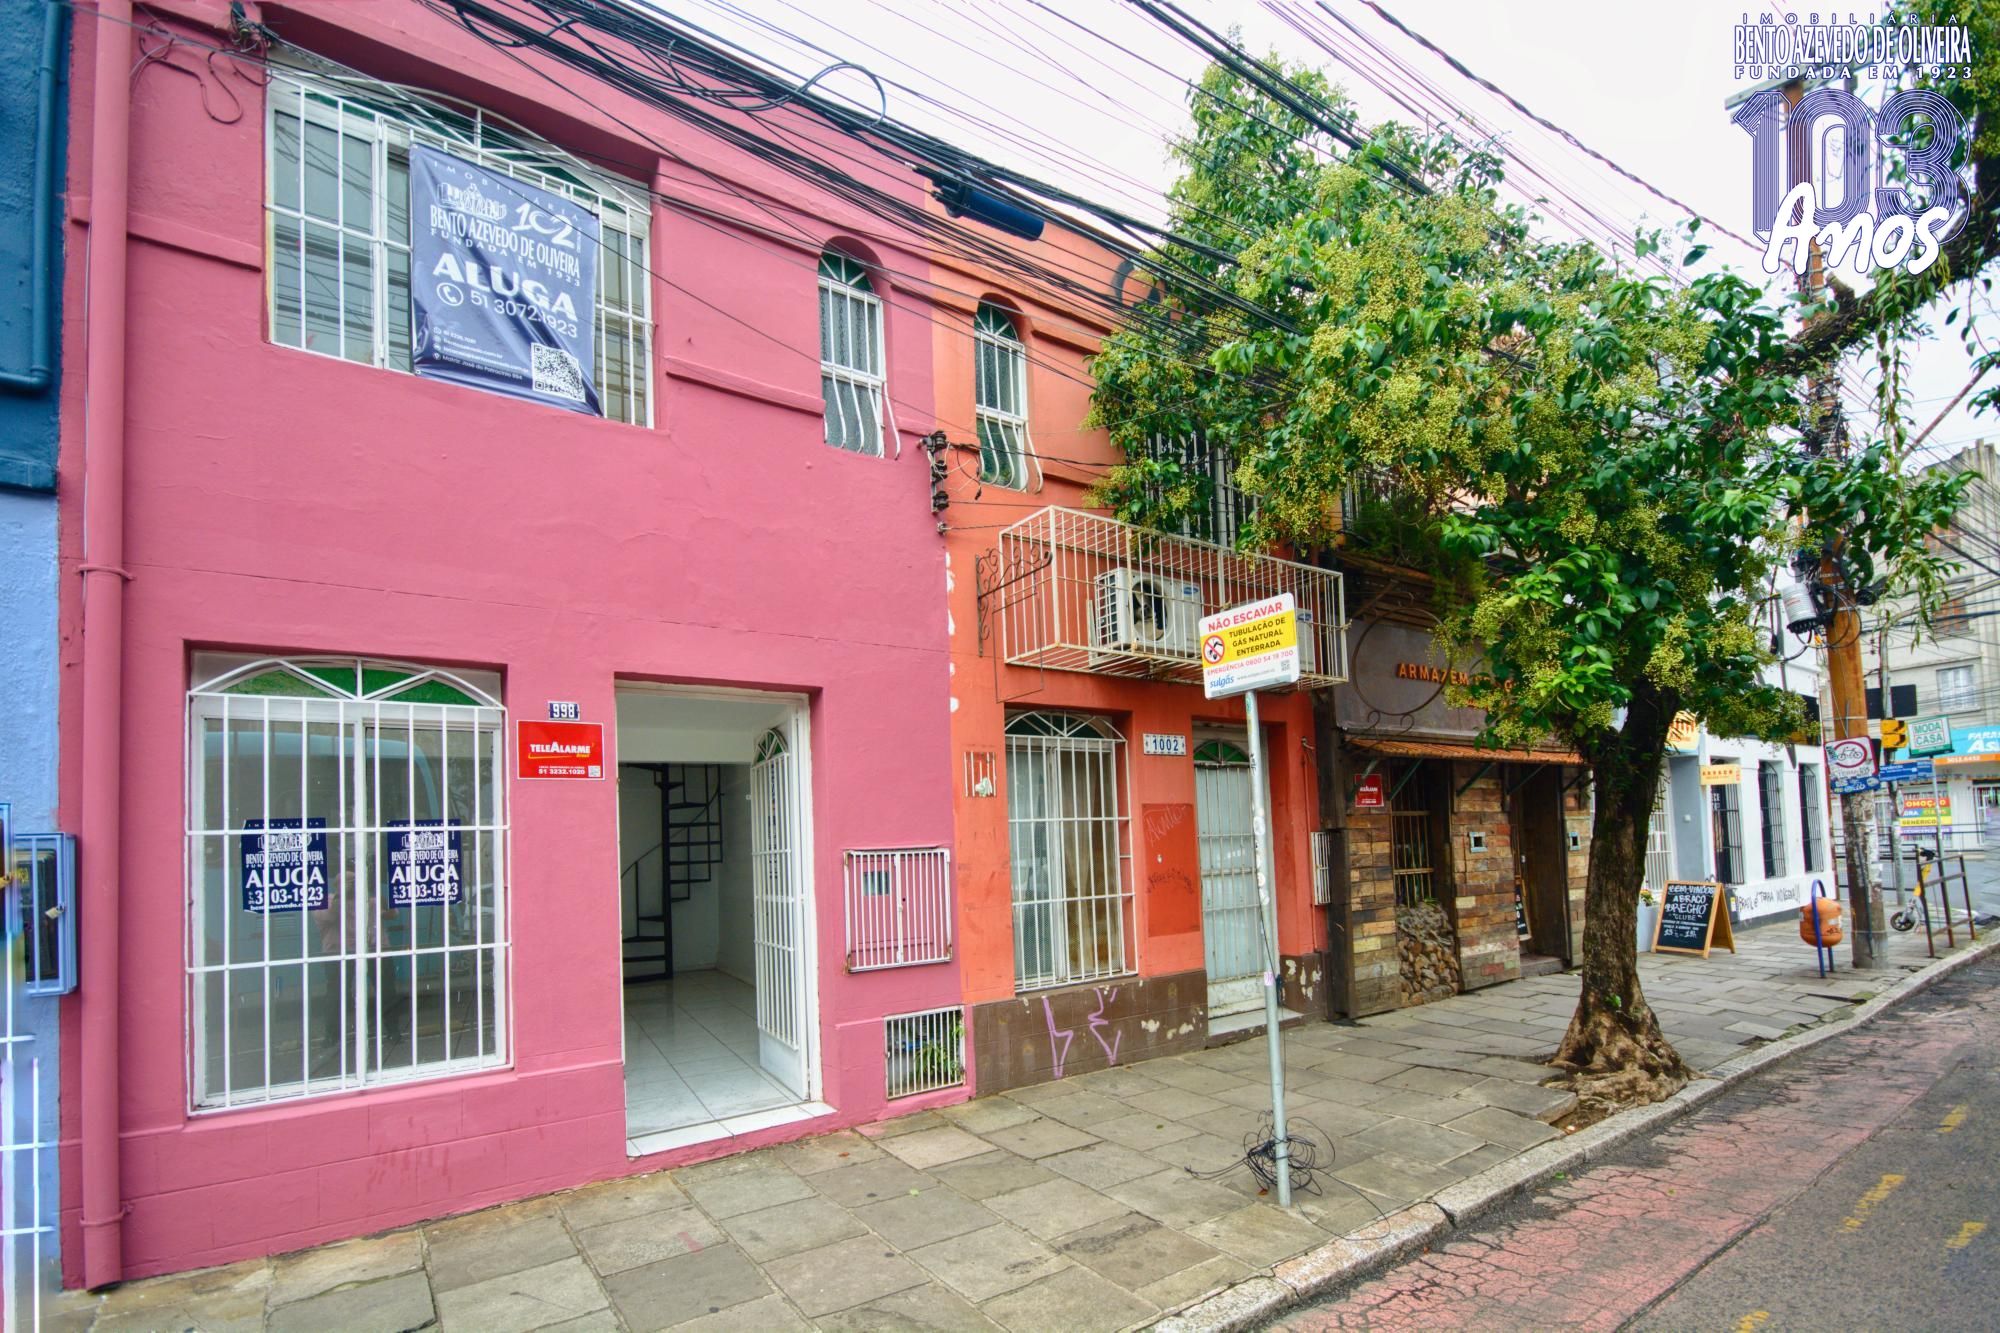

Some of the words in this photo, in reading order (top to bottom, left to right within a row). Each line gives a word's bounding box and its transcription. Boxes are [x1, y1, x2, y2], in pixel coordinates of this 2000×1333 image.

[430, 204, 467, 237] BENTO
[468, 217, 519, 253] AZEVEDO
[520, 235, 535, 261] DE
[536, 242, 581, 279] OLIVEIRA
[431, 227, 508, 257] FUNDADA
[518, 255, 537, 269] EM
[548, 267, 580, 287] 1923
[432, 252, 578, 322] ALUGA
[470, 290, 489, 308] 51
[1208, 616, 1231, 633] NÃO
[1233, 601, 1283, 625] ESCAVAR
[1229, 620, 1274, 638] TUBULAÇÃO
[1275, 616, 1286, 627] DE
[1248, 630, 1284, 645] NATURAL
[1236, 639, 1281, 657] ENTERRADA
[1207, 660, 1244, 676] EMERGÊNCIA
[1210, 674, 1235, 689] sulgás
[553, 703, 575, 718] 998
[1913, 722, 1941, 734] MODA
[1152, 738, 1179, 752] 1002
[1916, 733, 1943, 746] CASA
[246, 853, 265, 865] BENTO
[265, 851, 291, 863] ZEVEDO
[291, 851, 300, 863] DE
[430, 850, 437, 861] DE
[391, 864, 459, 884] ALUGA
